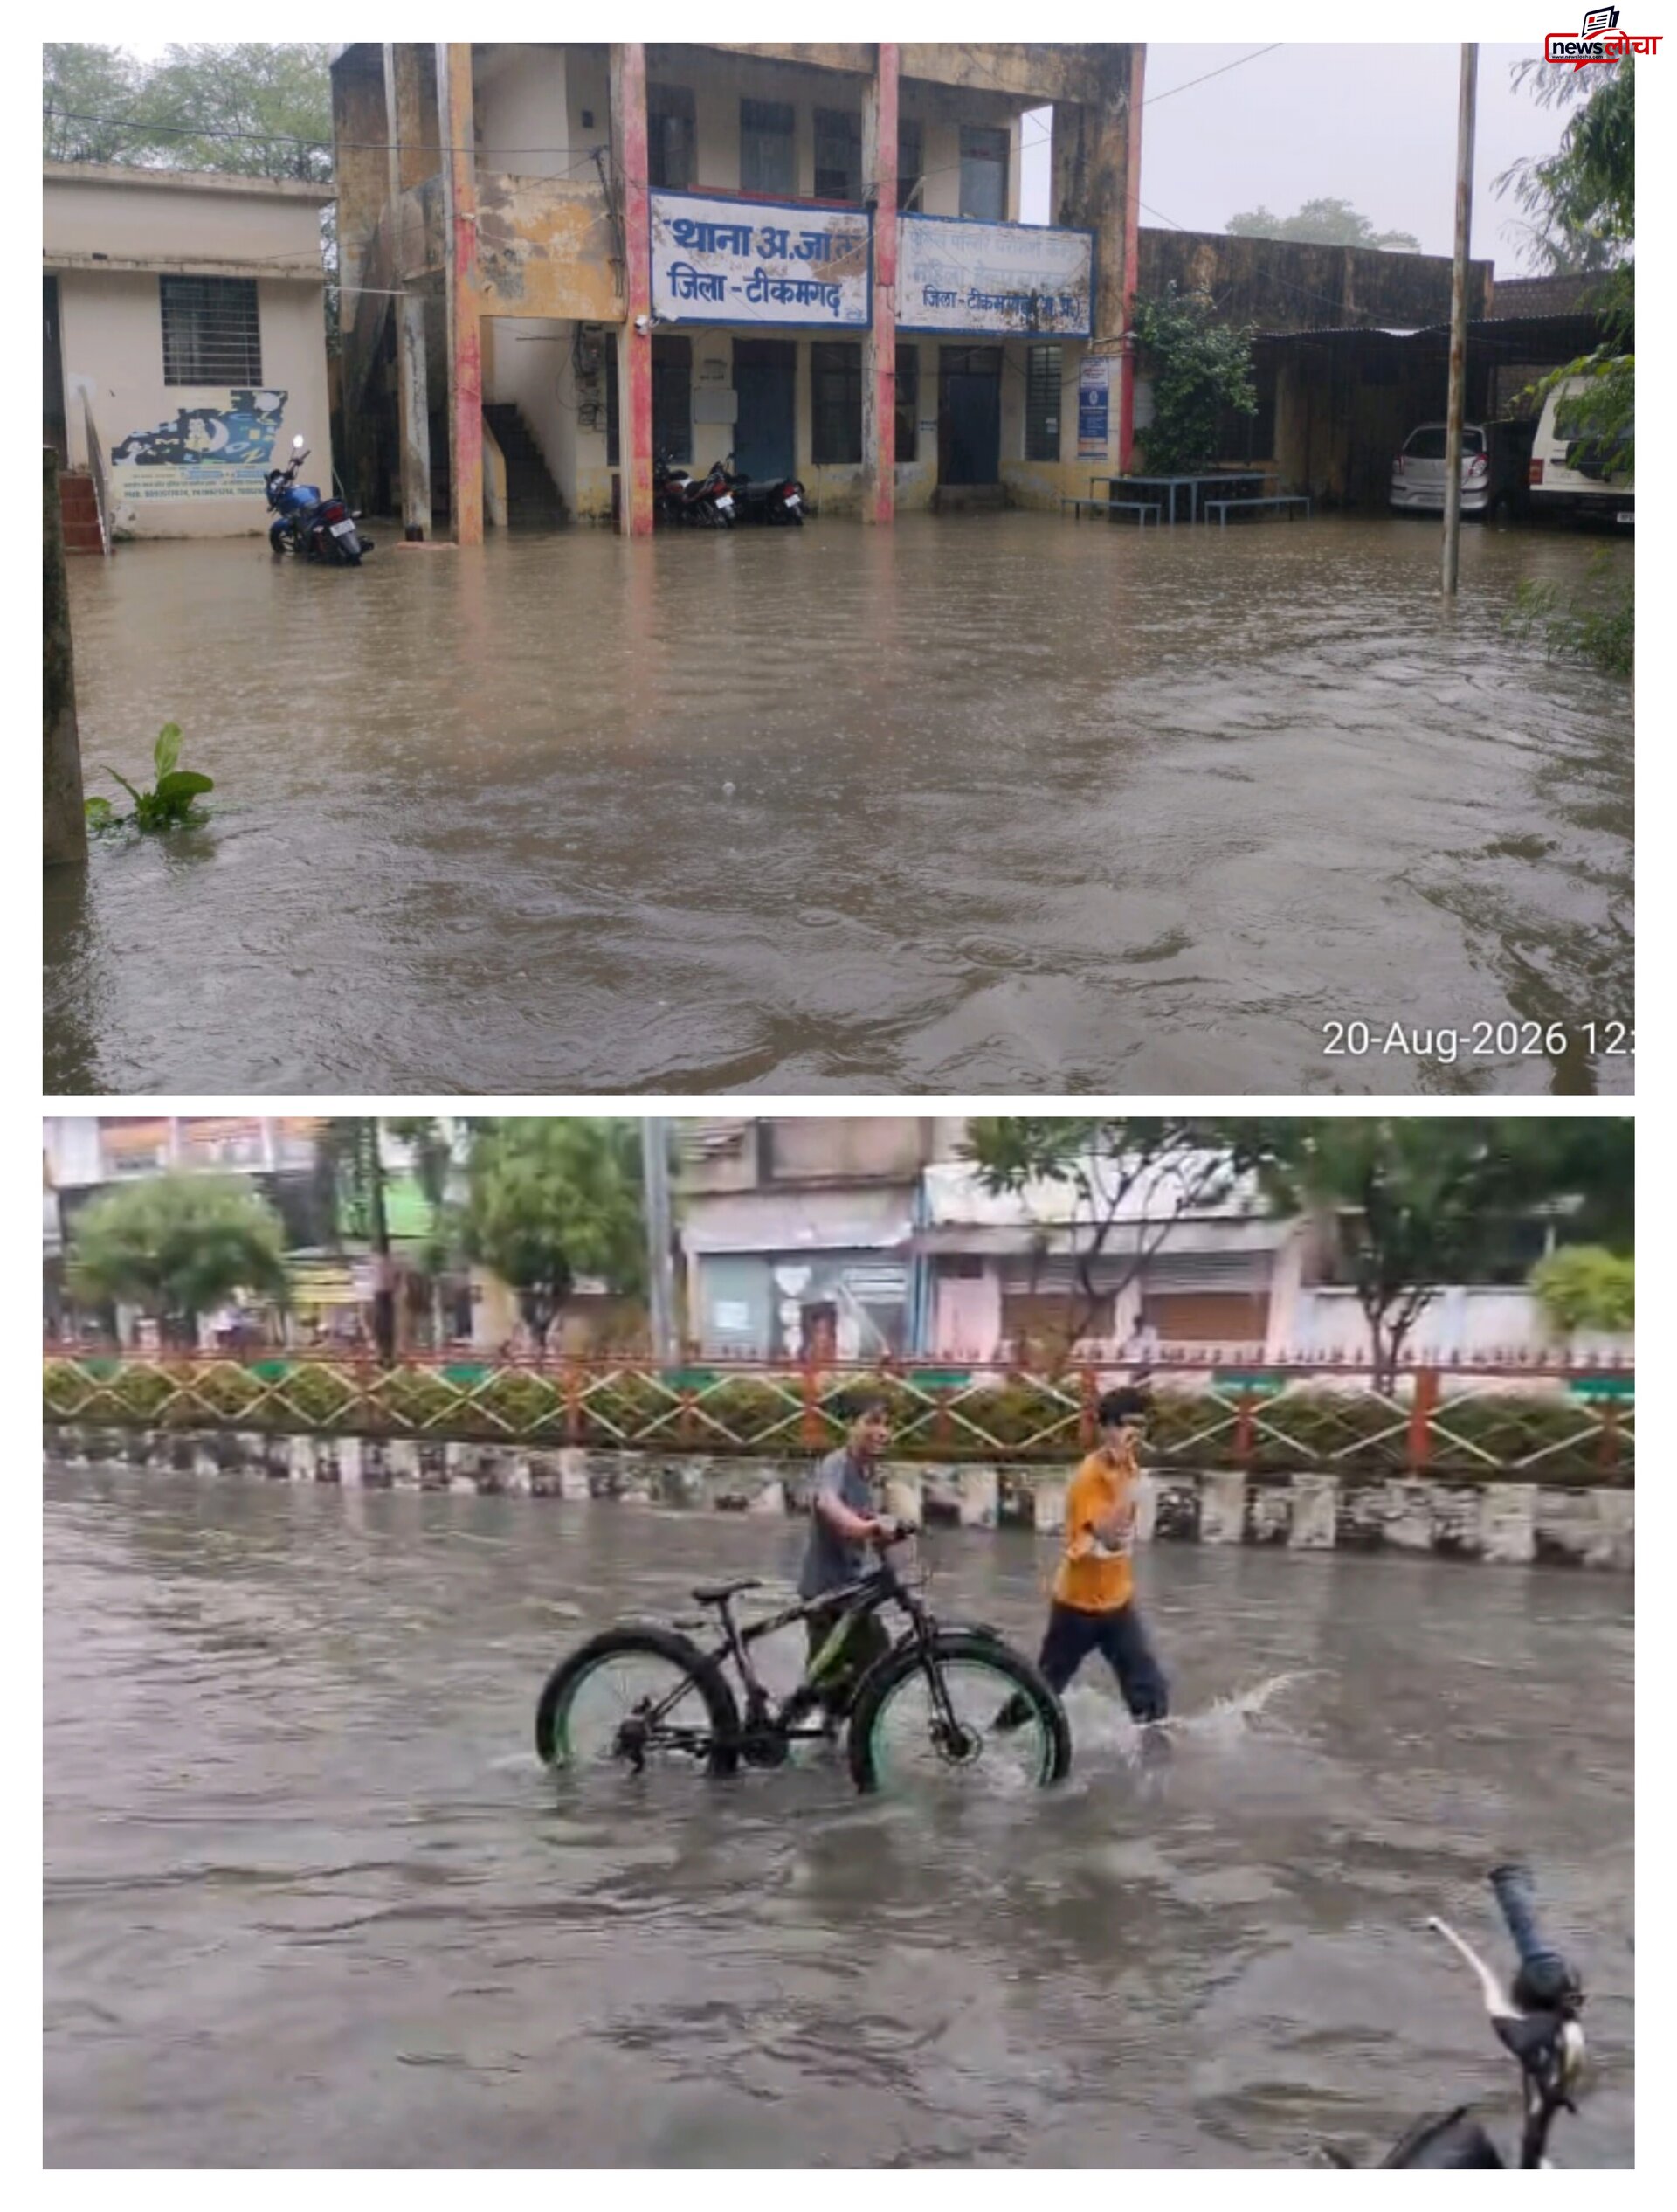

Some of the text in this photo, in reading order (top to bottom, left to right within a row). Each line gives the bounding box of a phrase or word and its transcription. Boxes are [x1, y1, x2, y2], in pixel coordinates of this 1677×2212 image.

[664, 218, 753, 257] थाना
[667, 262, 727, 301] जिला
[922, 285, 957, 308] जिला
